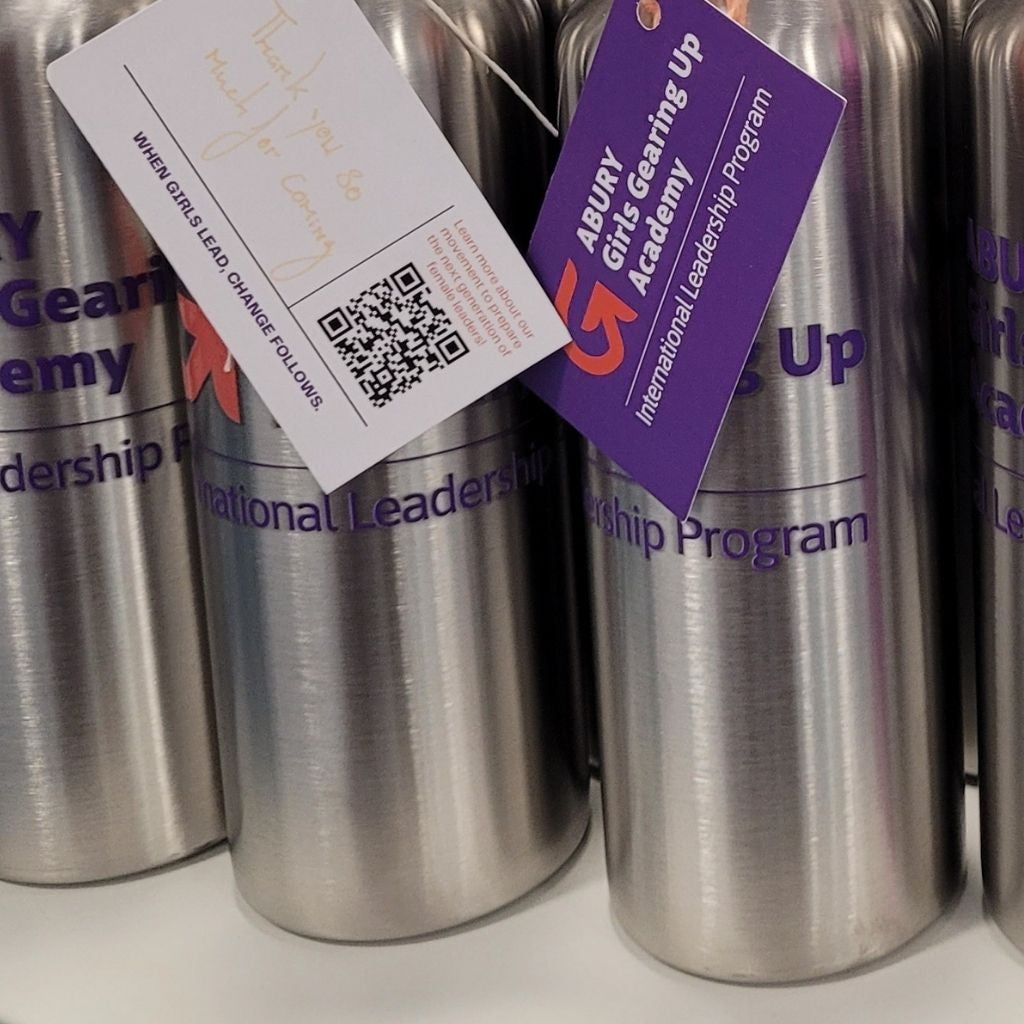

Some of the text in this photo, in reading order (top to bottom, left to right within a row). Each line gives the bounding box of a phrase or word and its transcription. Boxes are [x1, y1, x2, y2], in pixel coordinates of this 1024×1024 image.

[576, 145, 624, 254] ABURY
[602, 32, 704, 271] Girls Gearing Up
[133, 131, 323, 412] WHEN GIRLS LEAD, CHANGE FOLLOWS.
[426, 261, 456, 302] female
[454, 219, 535, 339] Learn more about our
[628, 157, 694, 296] Academy
[635, 87, 772, 427] International Leadership Program
[0, 254, 176, 328] Geari
[426, 235, 513, 357] the next generation of
[440, 227, 522, 349] movement to prepare
[778, 323, 867, 386] Up
[347, 444, 550, 532] Leadership
[677, 511, 869, 571] Program
